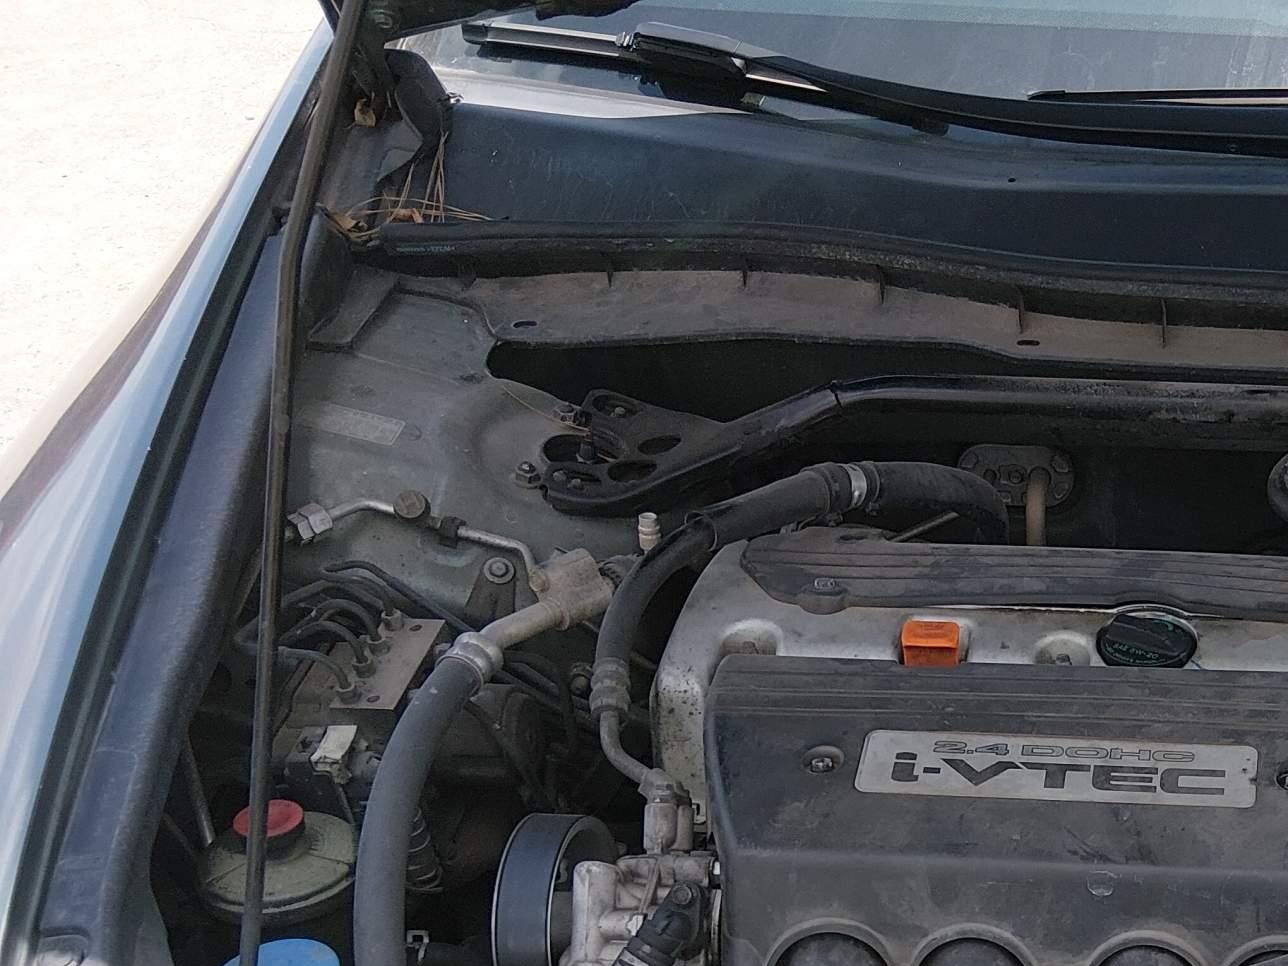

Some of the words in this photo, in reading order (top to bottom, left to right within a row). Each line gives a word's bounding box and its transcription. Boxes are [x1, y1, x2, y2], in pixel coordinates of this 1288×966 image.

[933, 740, 1010, 757] 2.4
[1020, 744, 1195, 763] DOHC
[890, 751, 1226, 795] i-VTEC
